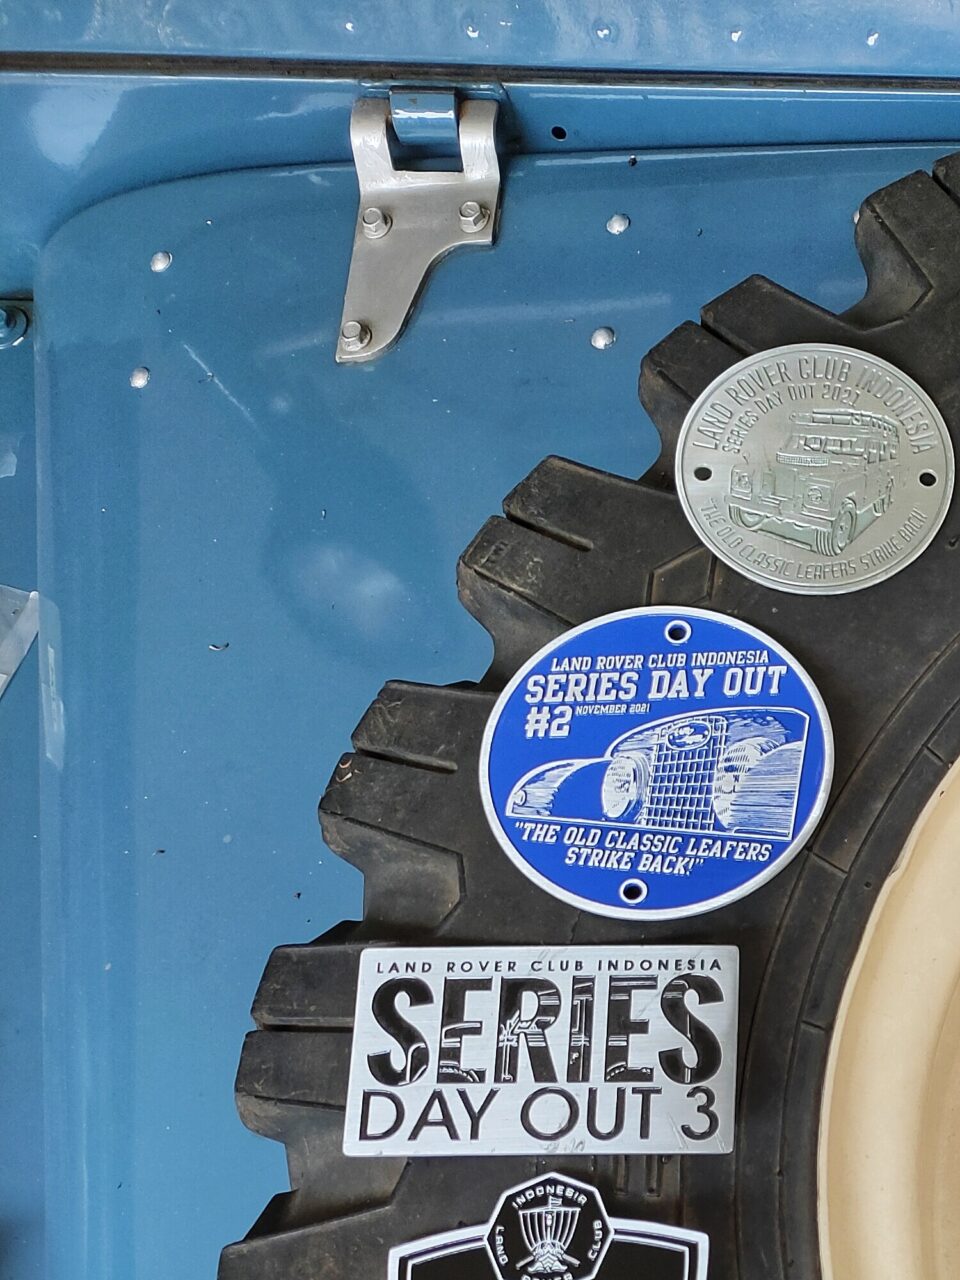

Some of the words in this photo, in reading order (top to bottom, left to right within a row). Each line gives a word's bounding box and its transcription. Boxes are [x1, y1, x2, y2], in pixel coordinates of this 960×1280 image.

[693, 403, 733, 450] LAND
[725, 362, 792, 405] ROVER
[799, 355, 851, 382] CLUB
[857, 365, 934, 454] INDONESIA
[722, 411, 759, 454] SERIES
[757, 392, 784, 414] DAY
[788, 384, 815, 401] OUT
[821, 384, 861, 407] 2021
[717, 521, 741, 549] OLD
[739, 543, 795, 575] CLASSIC
[796, 557, 857, 580] LEAFERS
[860, 533, 903, 570] STRIKE
[551, 656, 592, 671] LAND
[597, 655, 643, 670] ROVER
[648, 653, 686, 667] CLUB
[690, 650, 769, 666] INDONESIA
[524, 672, 639, 703] SERIES
[648, 669, 714, 699] DAY
[723, 666, 788, 696] OUT
[525, 706, 573, 739] #2
[575, 704, 628, 716] NOVEMBER
[629, 703, 651, 714] 2021
[563, 826, 601, 846] OLD
[605, 829, 684, 856] CLASSIC
[685, 838, 772, 862] LEAFERS
[565, 848, 634, 871] STRIKE
[376, 961, 432, 974] LAND
[446, 961, 517, 973] ROVER
[530, 959, 584, 972] CLUB
[597, 958, 723, 972] INDONESIA
[367, 973, 725, 1087] SERIES
[358, 1087, 501, 1142] DAY
[519, 1086, 663, 1141] OUT
[680, 1086, 721, 1140] 3
[512, 1185, 588, 1208] INDONESIA
[496, 1225, 510, 1266] LAND
[587, 1219, 602, 1261] CLUB
